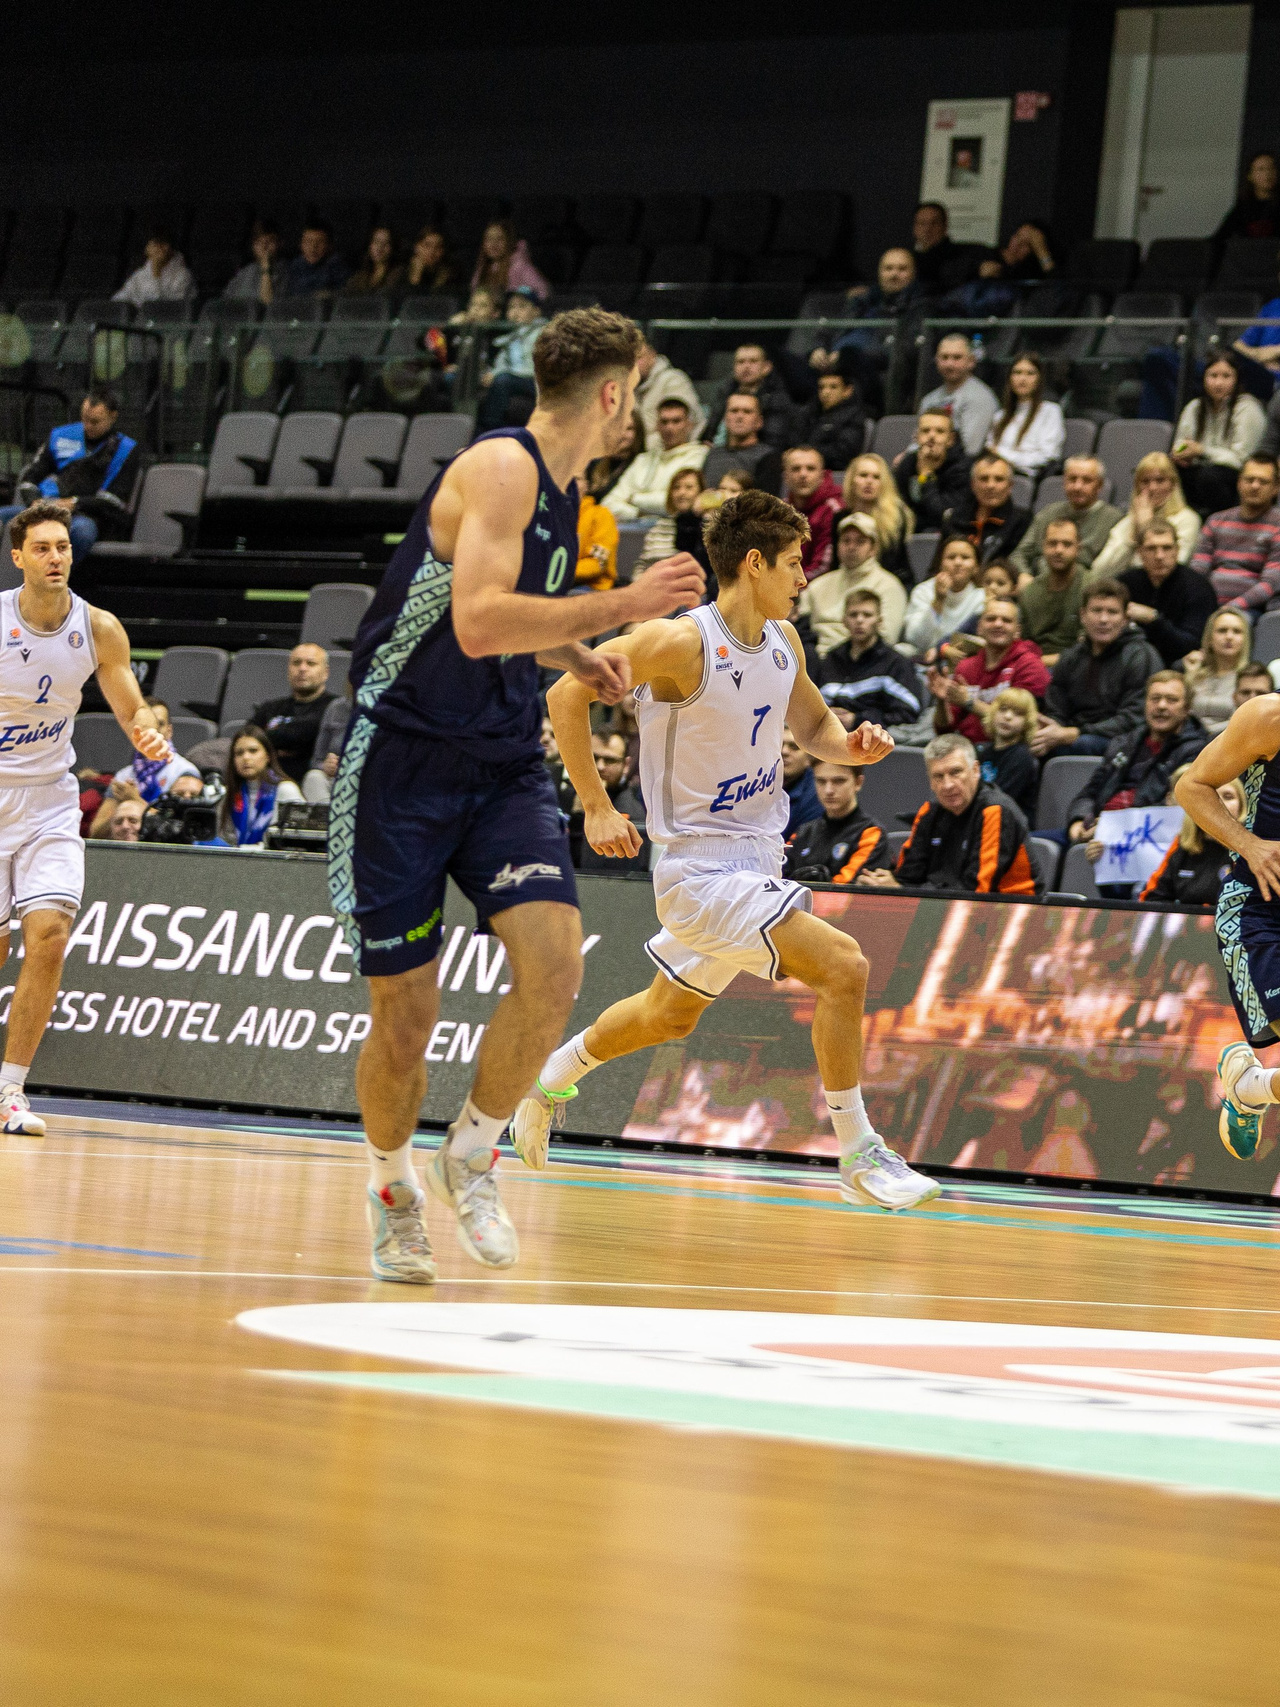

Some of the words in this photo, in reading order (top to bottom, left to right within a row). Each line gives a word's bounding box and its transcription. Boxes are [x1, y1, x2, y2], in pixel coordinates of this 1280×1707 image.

[545, 546, 568, 593] 0
[35, 674, 53, 704] 2
[751, 704, 772, 747] 7
[105, 995, 221, 1042] HOTEL
[227, 1006, 317, 1050] AND
